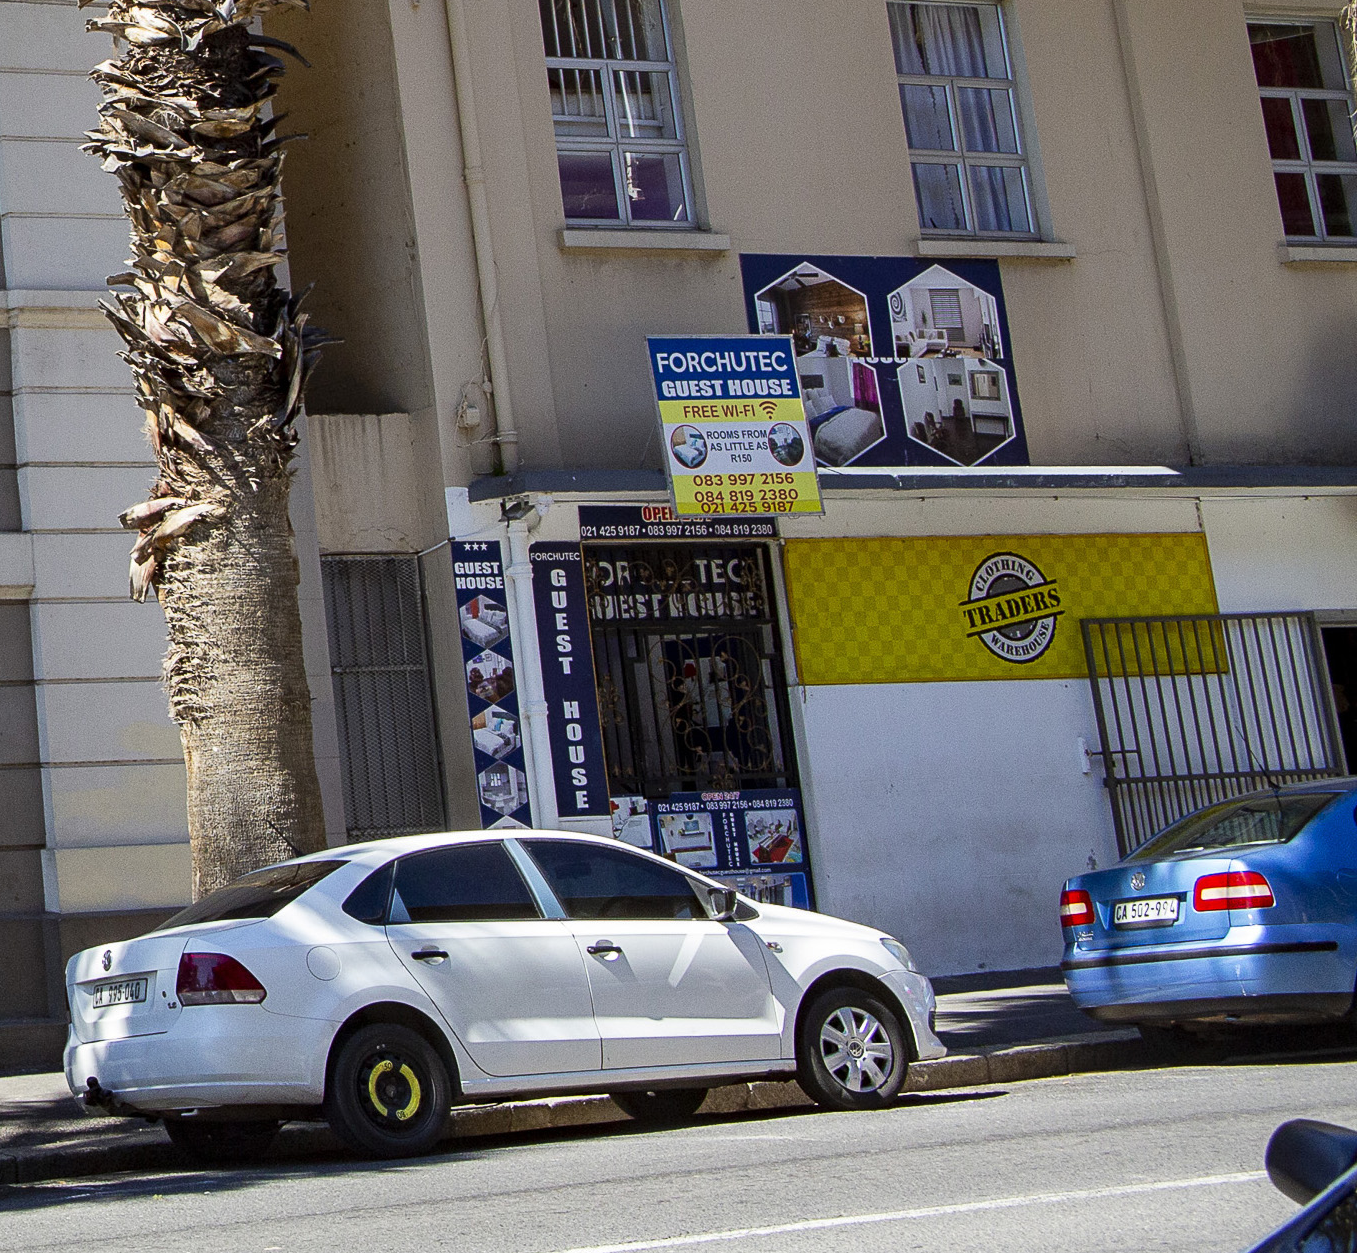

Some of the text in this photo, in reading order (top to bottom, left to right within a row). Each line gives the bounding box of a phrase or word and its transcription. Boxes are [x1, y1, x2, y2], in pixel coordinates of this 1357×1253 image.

[656, 351, 788, 373] FORCHUTEC
[661, 379, 793, 397] GUEST HOUSE
[683, 404, 756, 418] FREE WI-FI
[706, 430, 768, 439] ROOMS FROM
[710, 441, 768, 451] AS LITTLE AS
[731, 453, 752, 463] R150
[693, 472, 794, 487] 083 997 2156
[694, 488, 798, 503] 084 819 2380
[701, 501, 794, 514] 021 425 9187
[580, 524, 772, 537] 021 425 9187 083 997 2156 084 819 2380
[530, 552, 580, 561] FORCHUTEC
[454, 562, 500, 575] GUEST
[975, 559, 1035, 592] CLOTHING
[456, 576, 504, 589] HOUSE
[963, 588, 1061, 628] TRADERS
[550, 569, 573, 675] GUEST
[991, 621, 1050, 656] WAREHOUSE
[563, 700, 589, 809] HOUSE
[701, 792, 724, 801] OPEN
[657, 804, 670, 812] 021
[671, 803, 683, 811] 425
[684, 802, 700, 811] 9187
[706, 801, 718, 810] 083
[719, 801, 731, 809] 997
[752, 800, 764, 808] 084
[765, 799, 776, 807] 819
[778, 798, 793, 807] 2380
[1116, 900, 1175, 921] CA 502-994
